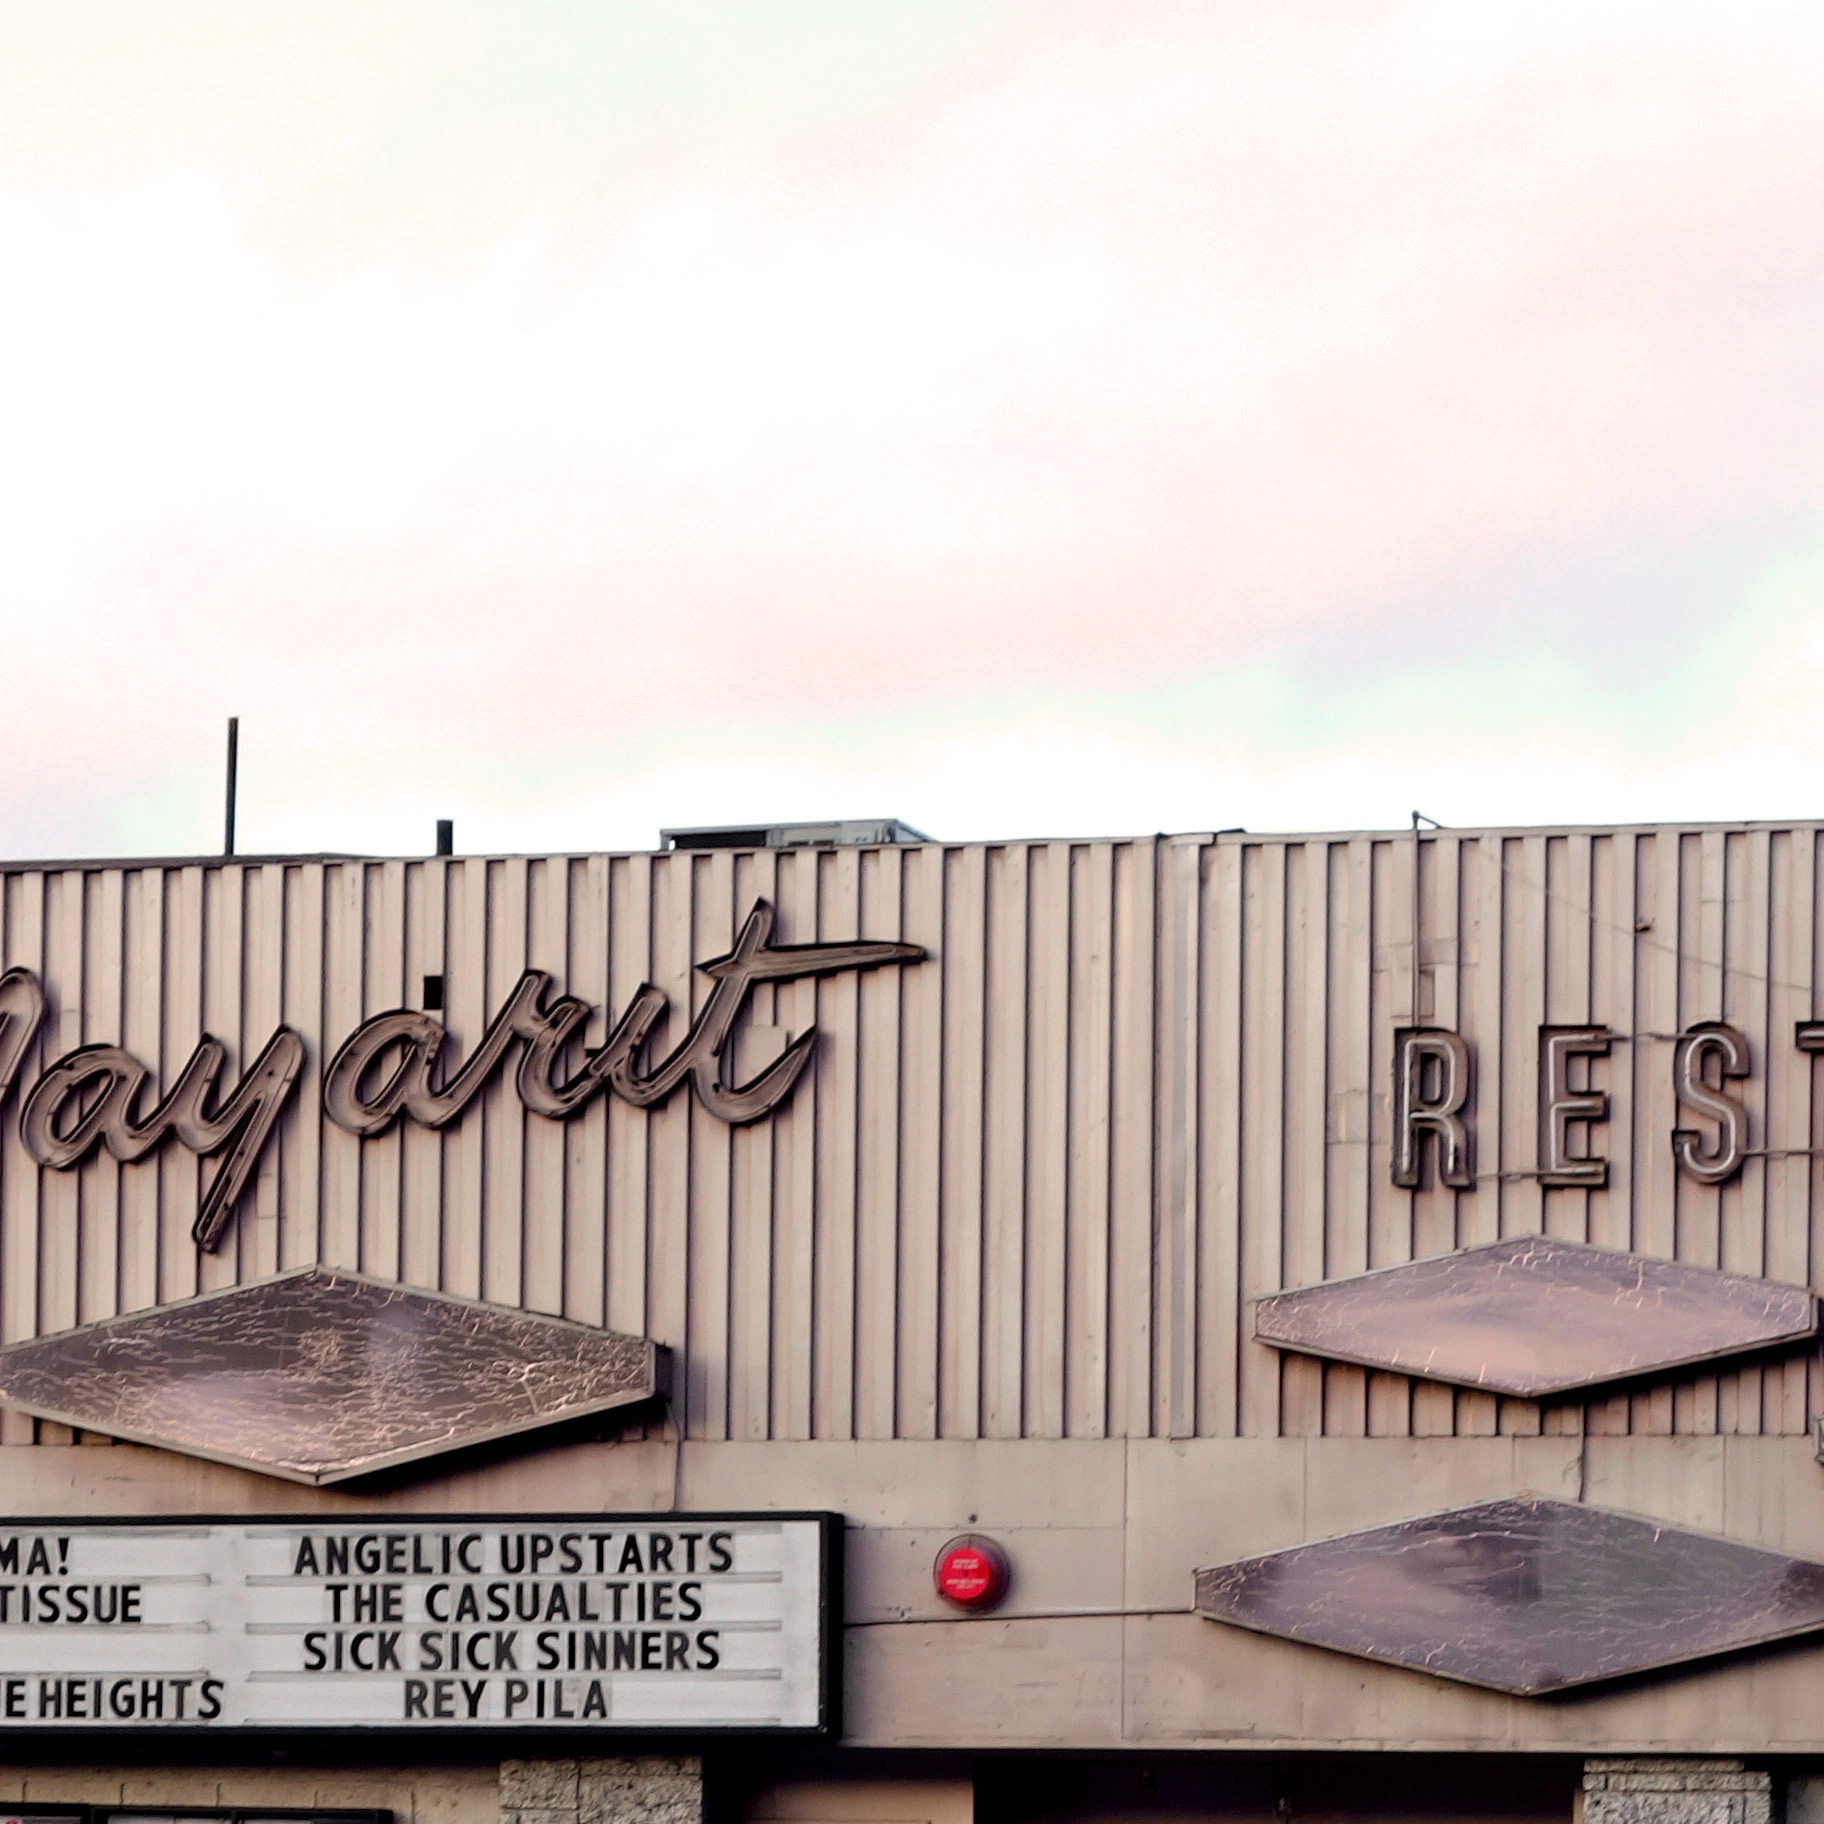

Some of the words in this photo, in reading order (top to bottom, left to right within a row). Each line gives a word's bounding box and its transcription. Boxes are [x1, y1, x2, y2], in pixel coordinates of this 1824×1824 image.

[293, 1534, 482, 1575] ANGELIC
[500, 1532, 733, 1574] UPSTARTS
[325, 1583, 403, 1622] THE
[425, 1582, 702, 1622] CASUALTIES
[304, 1631, 401, 1671] SICK
[419, 1631, 518, 1671] SICK
[536, 1631, 720, 1671] SINNERS
[38, 1679, 225, 1720] HEIGHTS
[404, 1679, 487, 1718] REY
[504, 1679, 608, 1719] PILA
